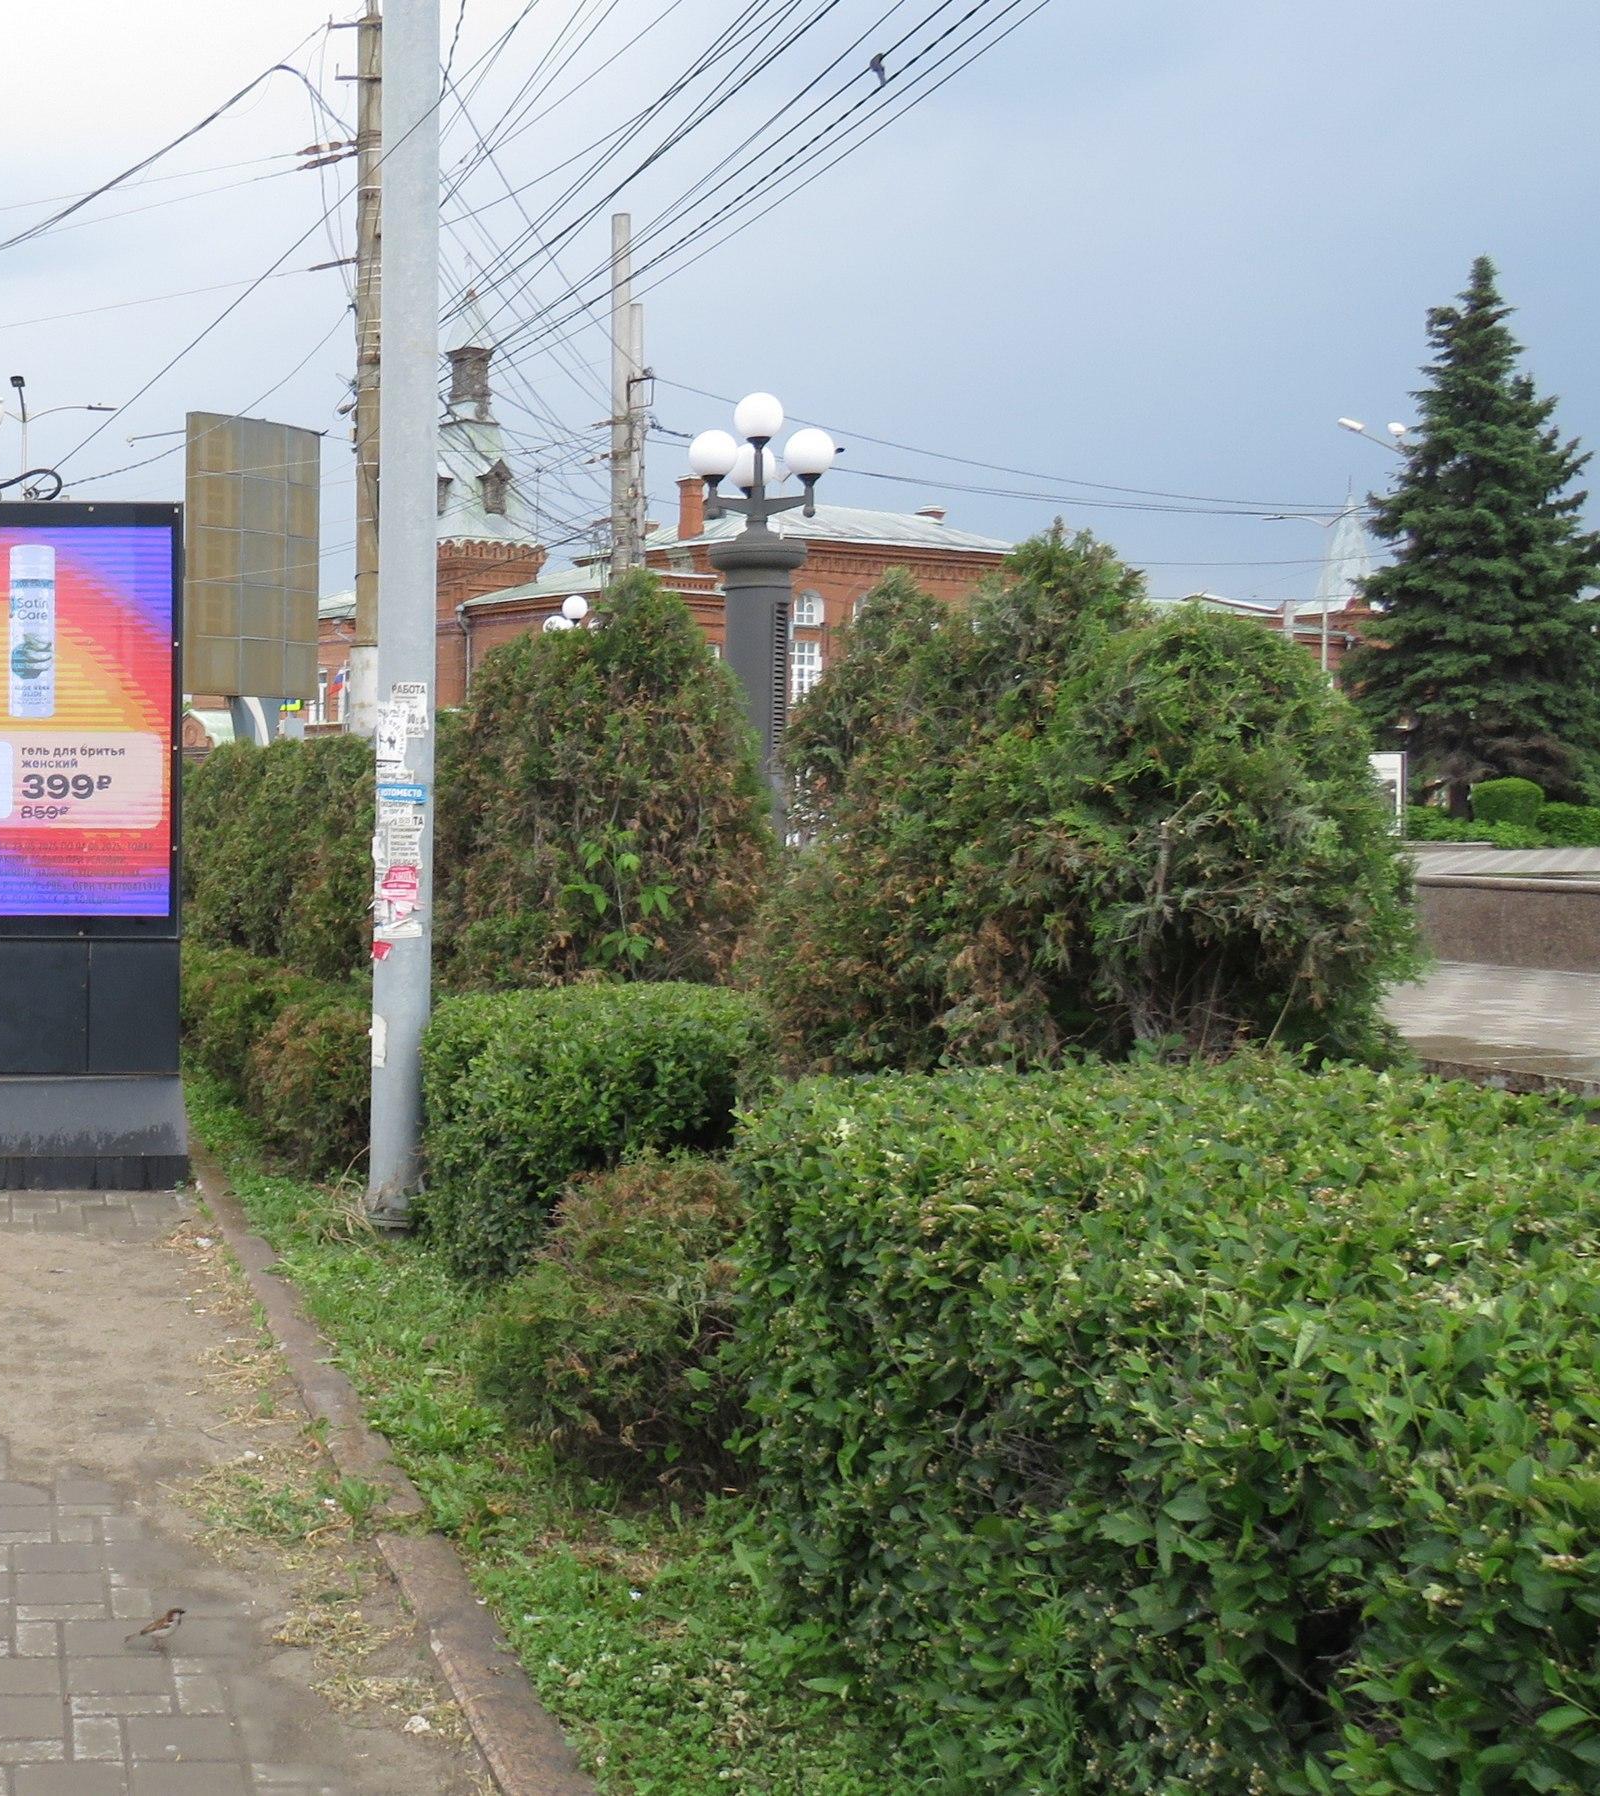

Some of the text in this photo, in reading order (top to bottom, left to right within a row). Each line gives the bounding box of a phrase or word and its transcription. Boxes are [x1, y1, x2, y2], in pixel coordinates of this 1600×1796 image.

[16, 597, 49, 609] Satin
[17, 610, 48, 621] Care
[391, 683, 426, 695] РАБОТА
[21, 744, 126, 757] гель для бритья
[21, 758, 79, 769] женский
[21, 774, 112, 800] 399₽
